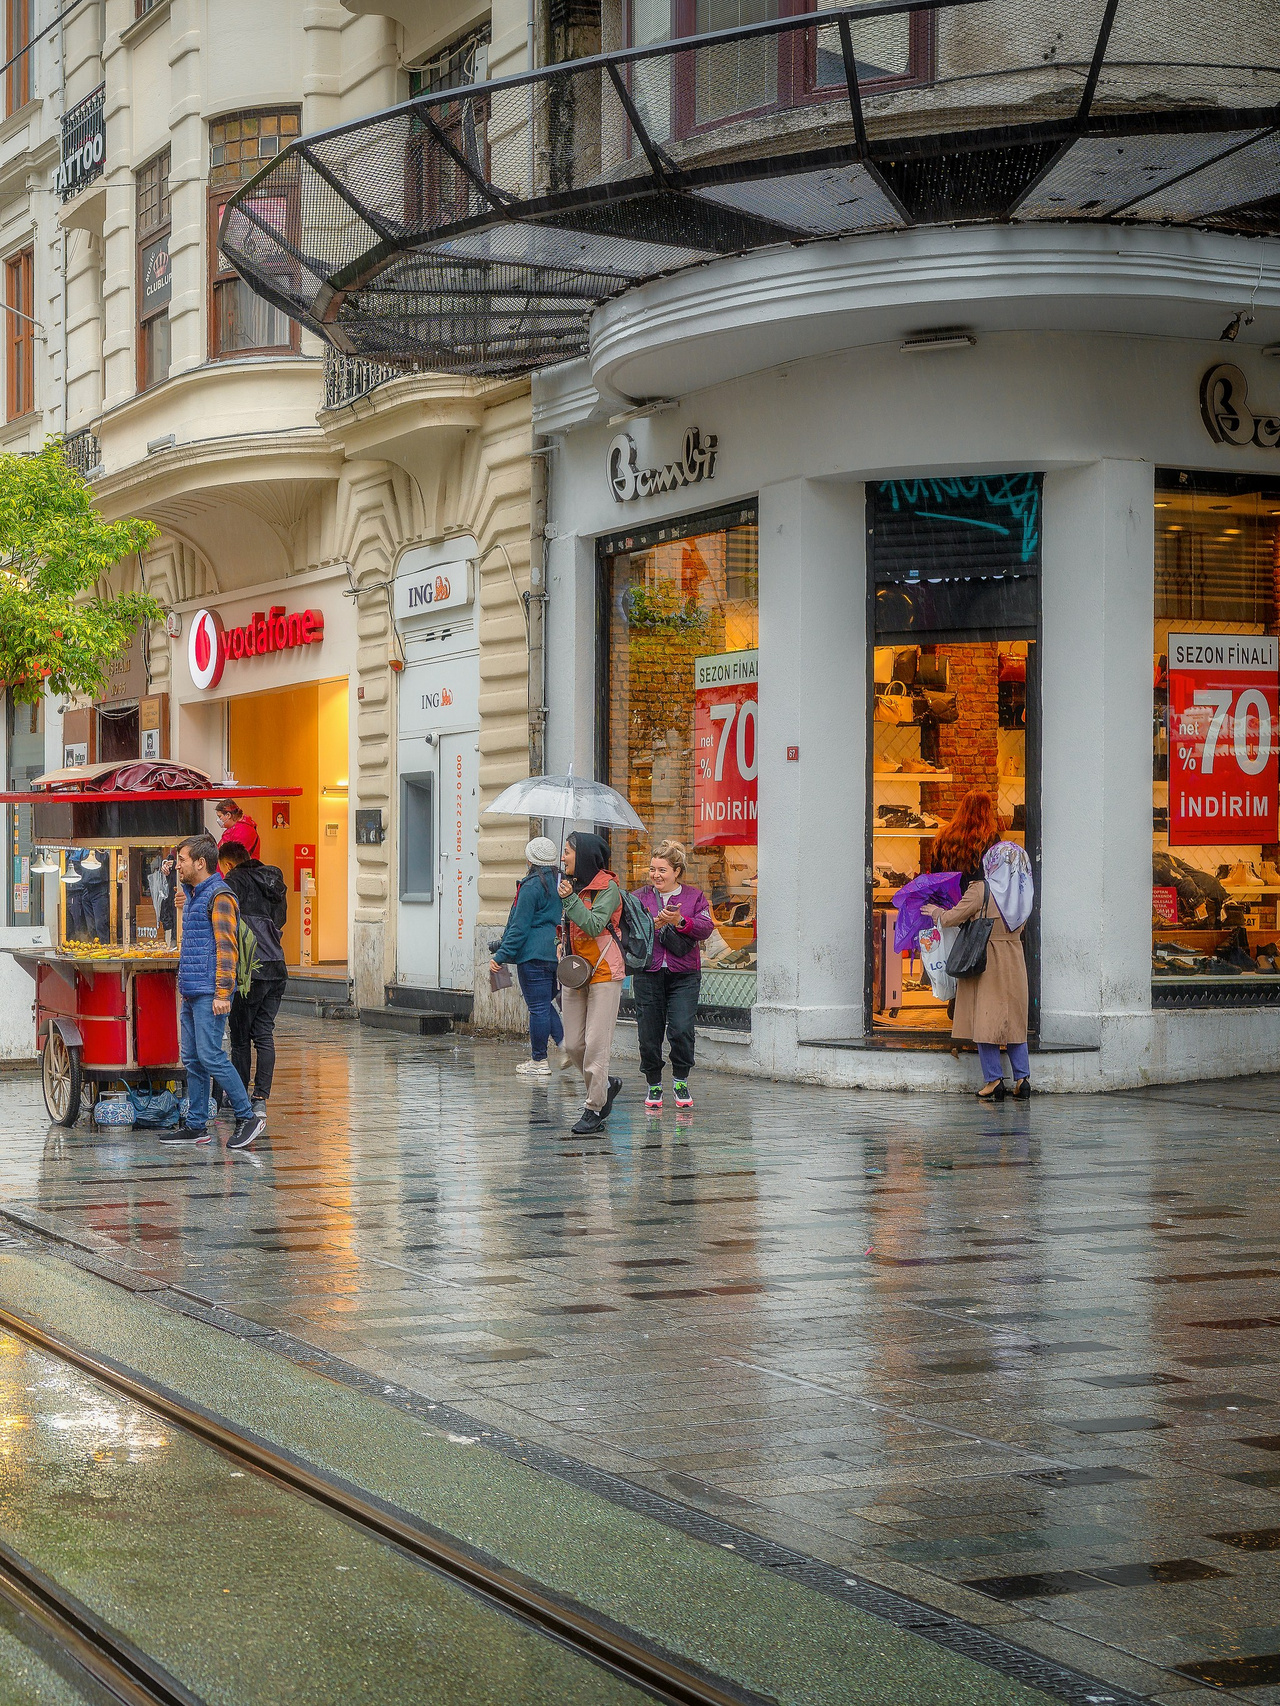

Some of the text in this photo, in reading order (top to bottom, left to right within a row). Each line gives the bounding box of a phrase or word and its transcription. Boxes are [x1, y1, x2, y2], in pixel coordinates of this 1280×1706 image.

[52, 133, 103, 195] TATTOO
[606, 427, 718, 502] Bambi
[408, 583, 433, 608] ING
[221, 606, 324, 660] vodafone
[1176, 642, 1272, 665] SEZON FİNALİ
[699, 658, 758, 683] SEZON FİNAL
[421, 692, 440, 710] ING
[709, 699, 758, 782] 70
[1178, 720, 1199, 736] net
[1193, 688, 1271, 776] 70
[700, 734, 714, 748] net
[700, 758, 712, 780] %
[1178, 747, 1197, 771] %
[701, 796, 758, 821] İNDİRİM
[1180, 791, 1269, 818] İNDİRİM
